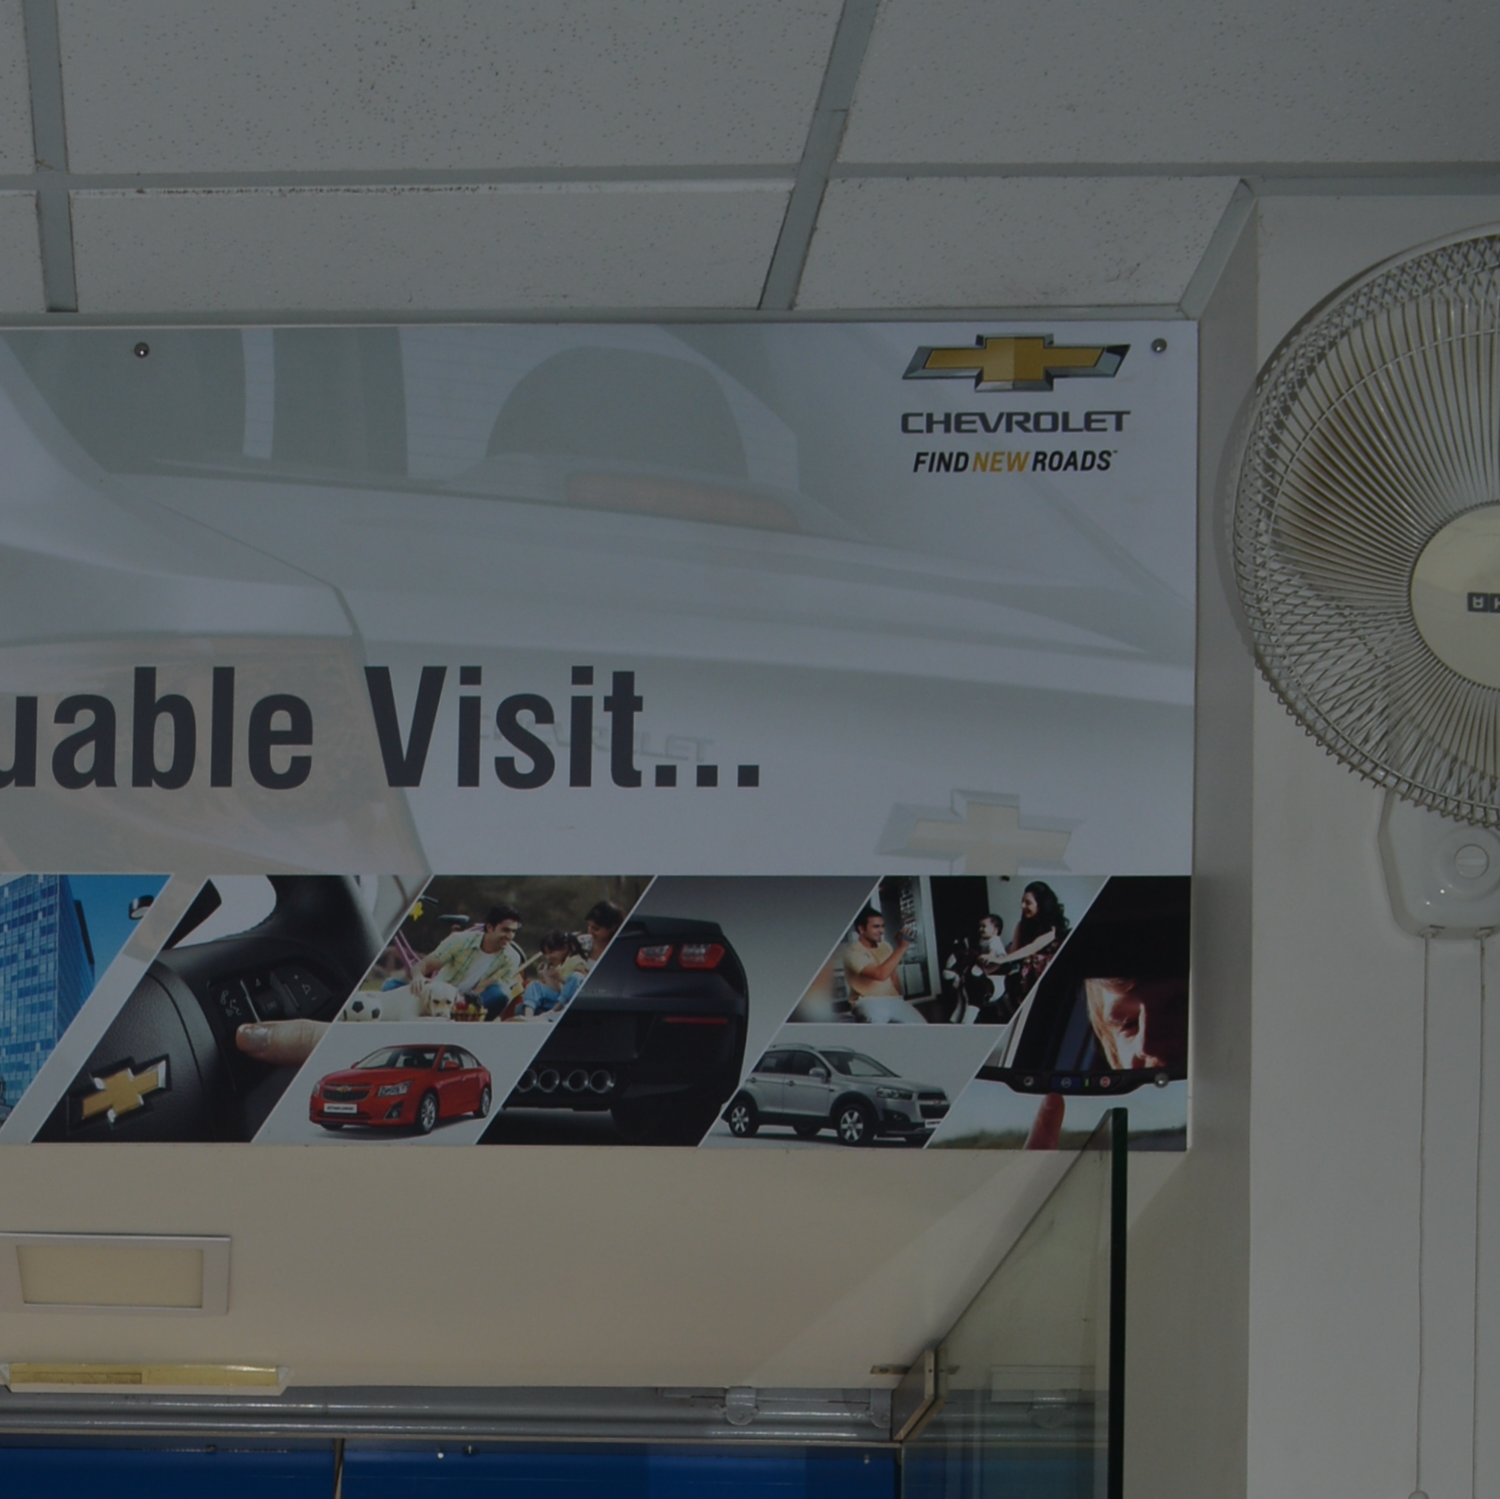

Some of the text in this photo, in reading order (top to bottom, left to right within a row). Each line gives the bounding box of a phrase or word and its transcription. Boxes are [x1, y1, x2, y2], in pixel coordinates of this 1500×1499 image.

[901, 410, 1132, 434] CHEVROLET
[913, 449, 1112, 473] FIND NEW ROADS
[363, 664, 760, 791] Visit...
